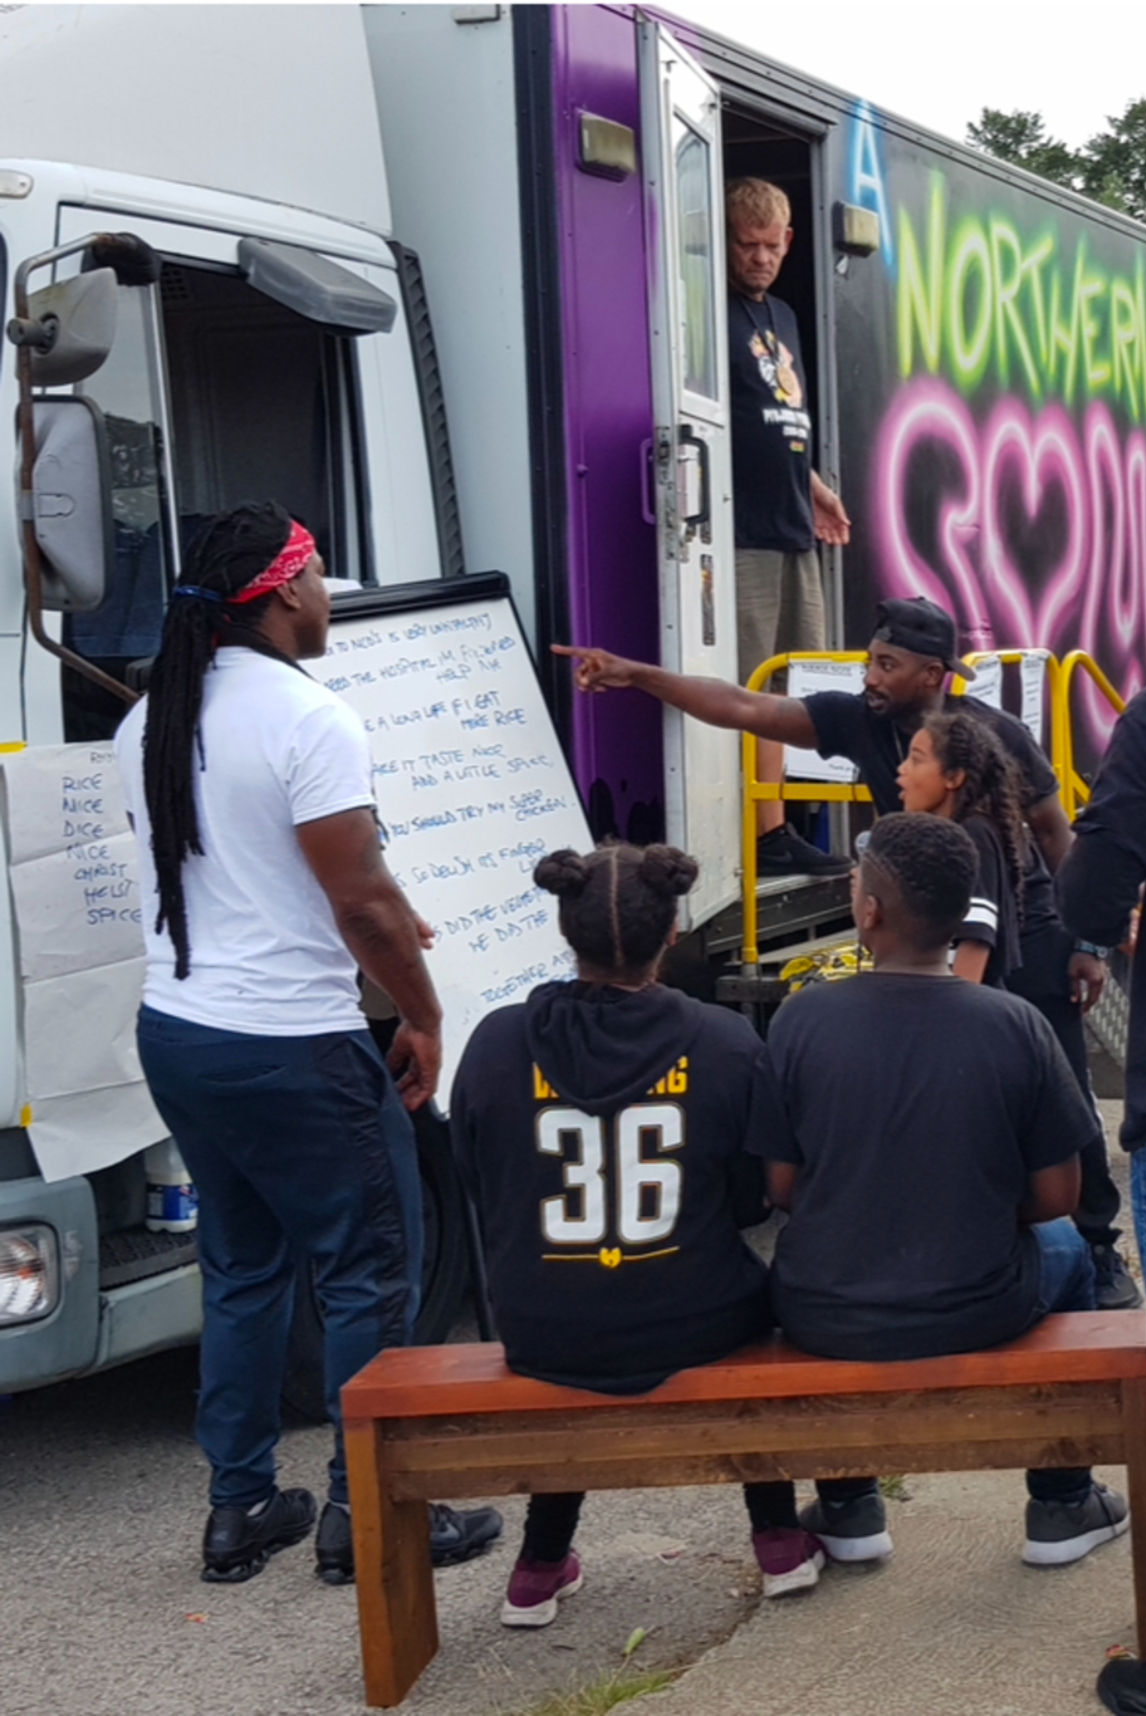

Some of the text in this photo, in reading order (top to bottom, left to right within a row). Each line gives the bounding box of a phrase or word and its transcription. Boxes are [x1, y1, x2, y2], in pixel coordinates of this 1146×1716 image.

[848, 96, 894, 278] A
[420, 749, 465, 771] TASTE
[62, 774, 103, 794] RICE
[63, 798, 104, 814] NICE
[64, 821, 105, 840] DICE
[67, 844, 110, 860] NICE
[88, 908, 142, 925] SPICE
[535, 1101, 687, 1245] 36
